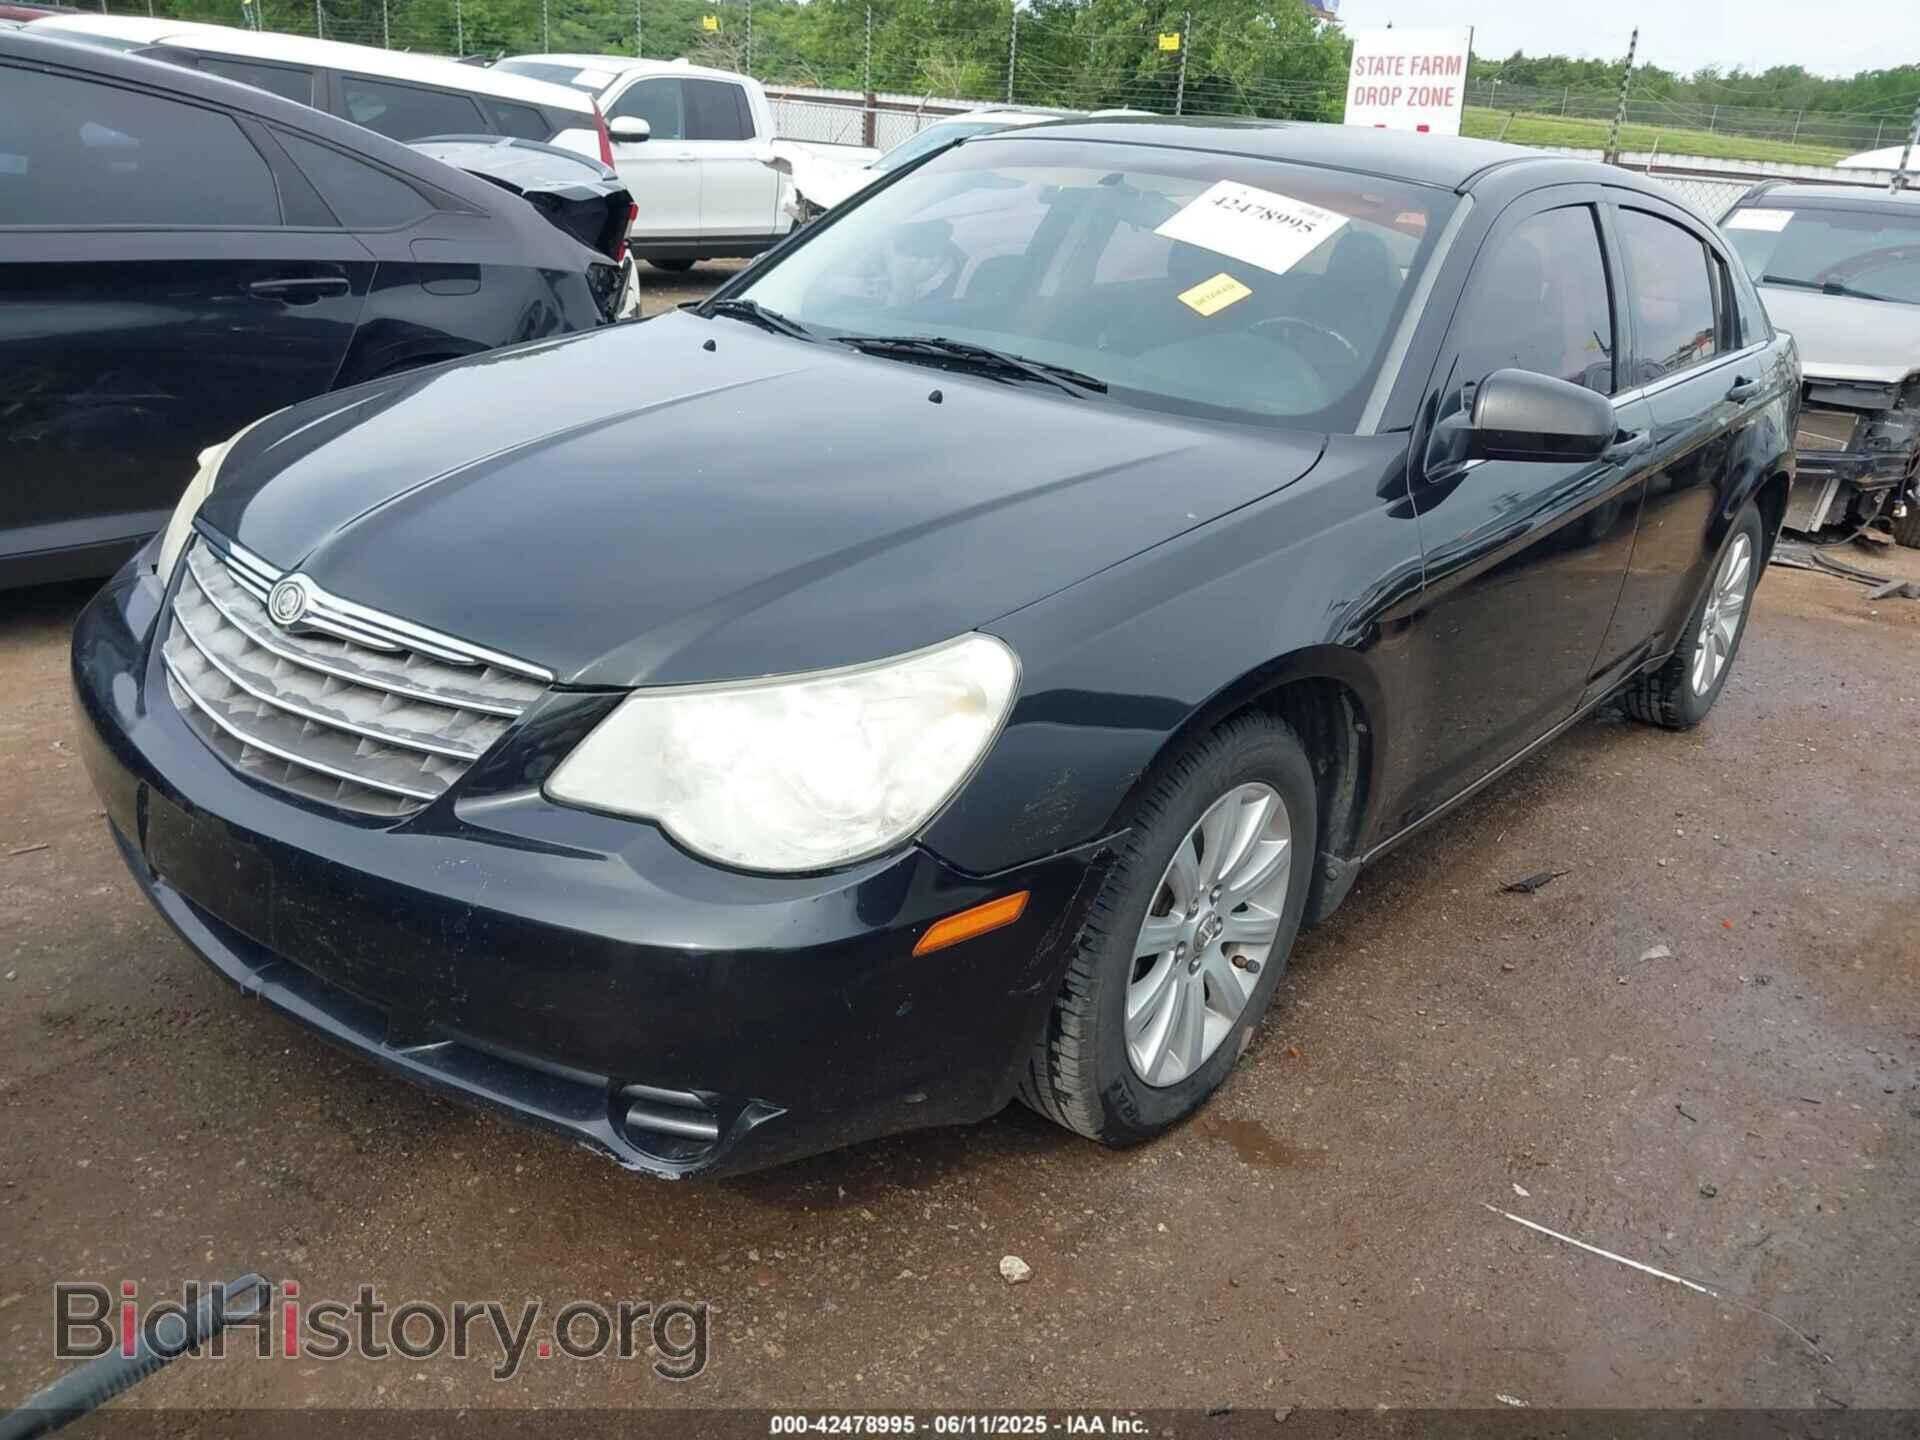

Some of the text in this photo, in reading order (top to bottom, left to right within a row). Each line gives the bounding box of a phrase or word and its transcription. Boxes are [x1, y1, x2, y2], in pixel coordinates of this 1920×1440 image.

[1355, 55, 1461, 76] STATE FARM
[1354, 87, 1455, 106] DROP ZONE
[1212, 196, 1318, 233] 42478995
